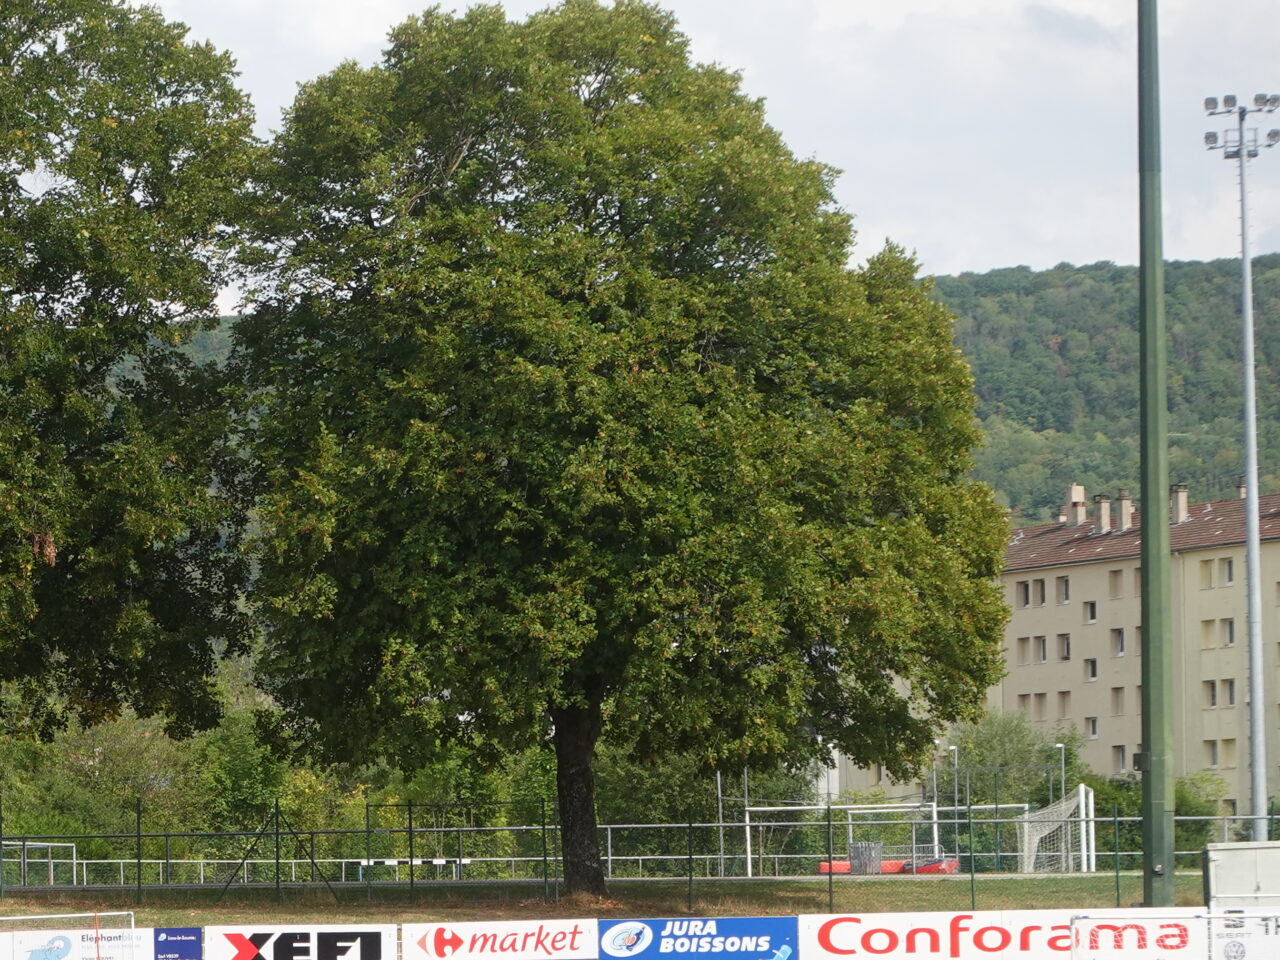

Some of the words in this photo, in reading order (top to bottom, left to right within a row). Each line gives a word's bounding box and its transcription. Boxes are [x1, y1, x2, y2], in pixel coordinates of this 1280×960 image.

[468, 924, 583, 956] market
[660, 920, 717, 936] JURA
[817, 914, 1189, 958] Conforama
[659, 936, 771, 953] BOISSONS
